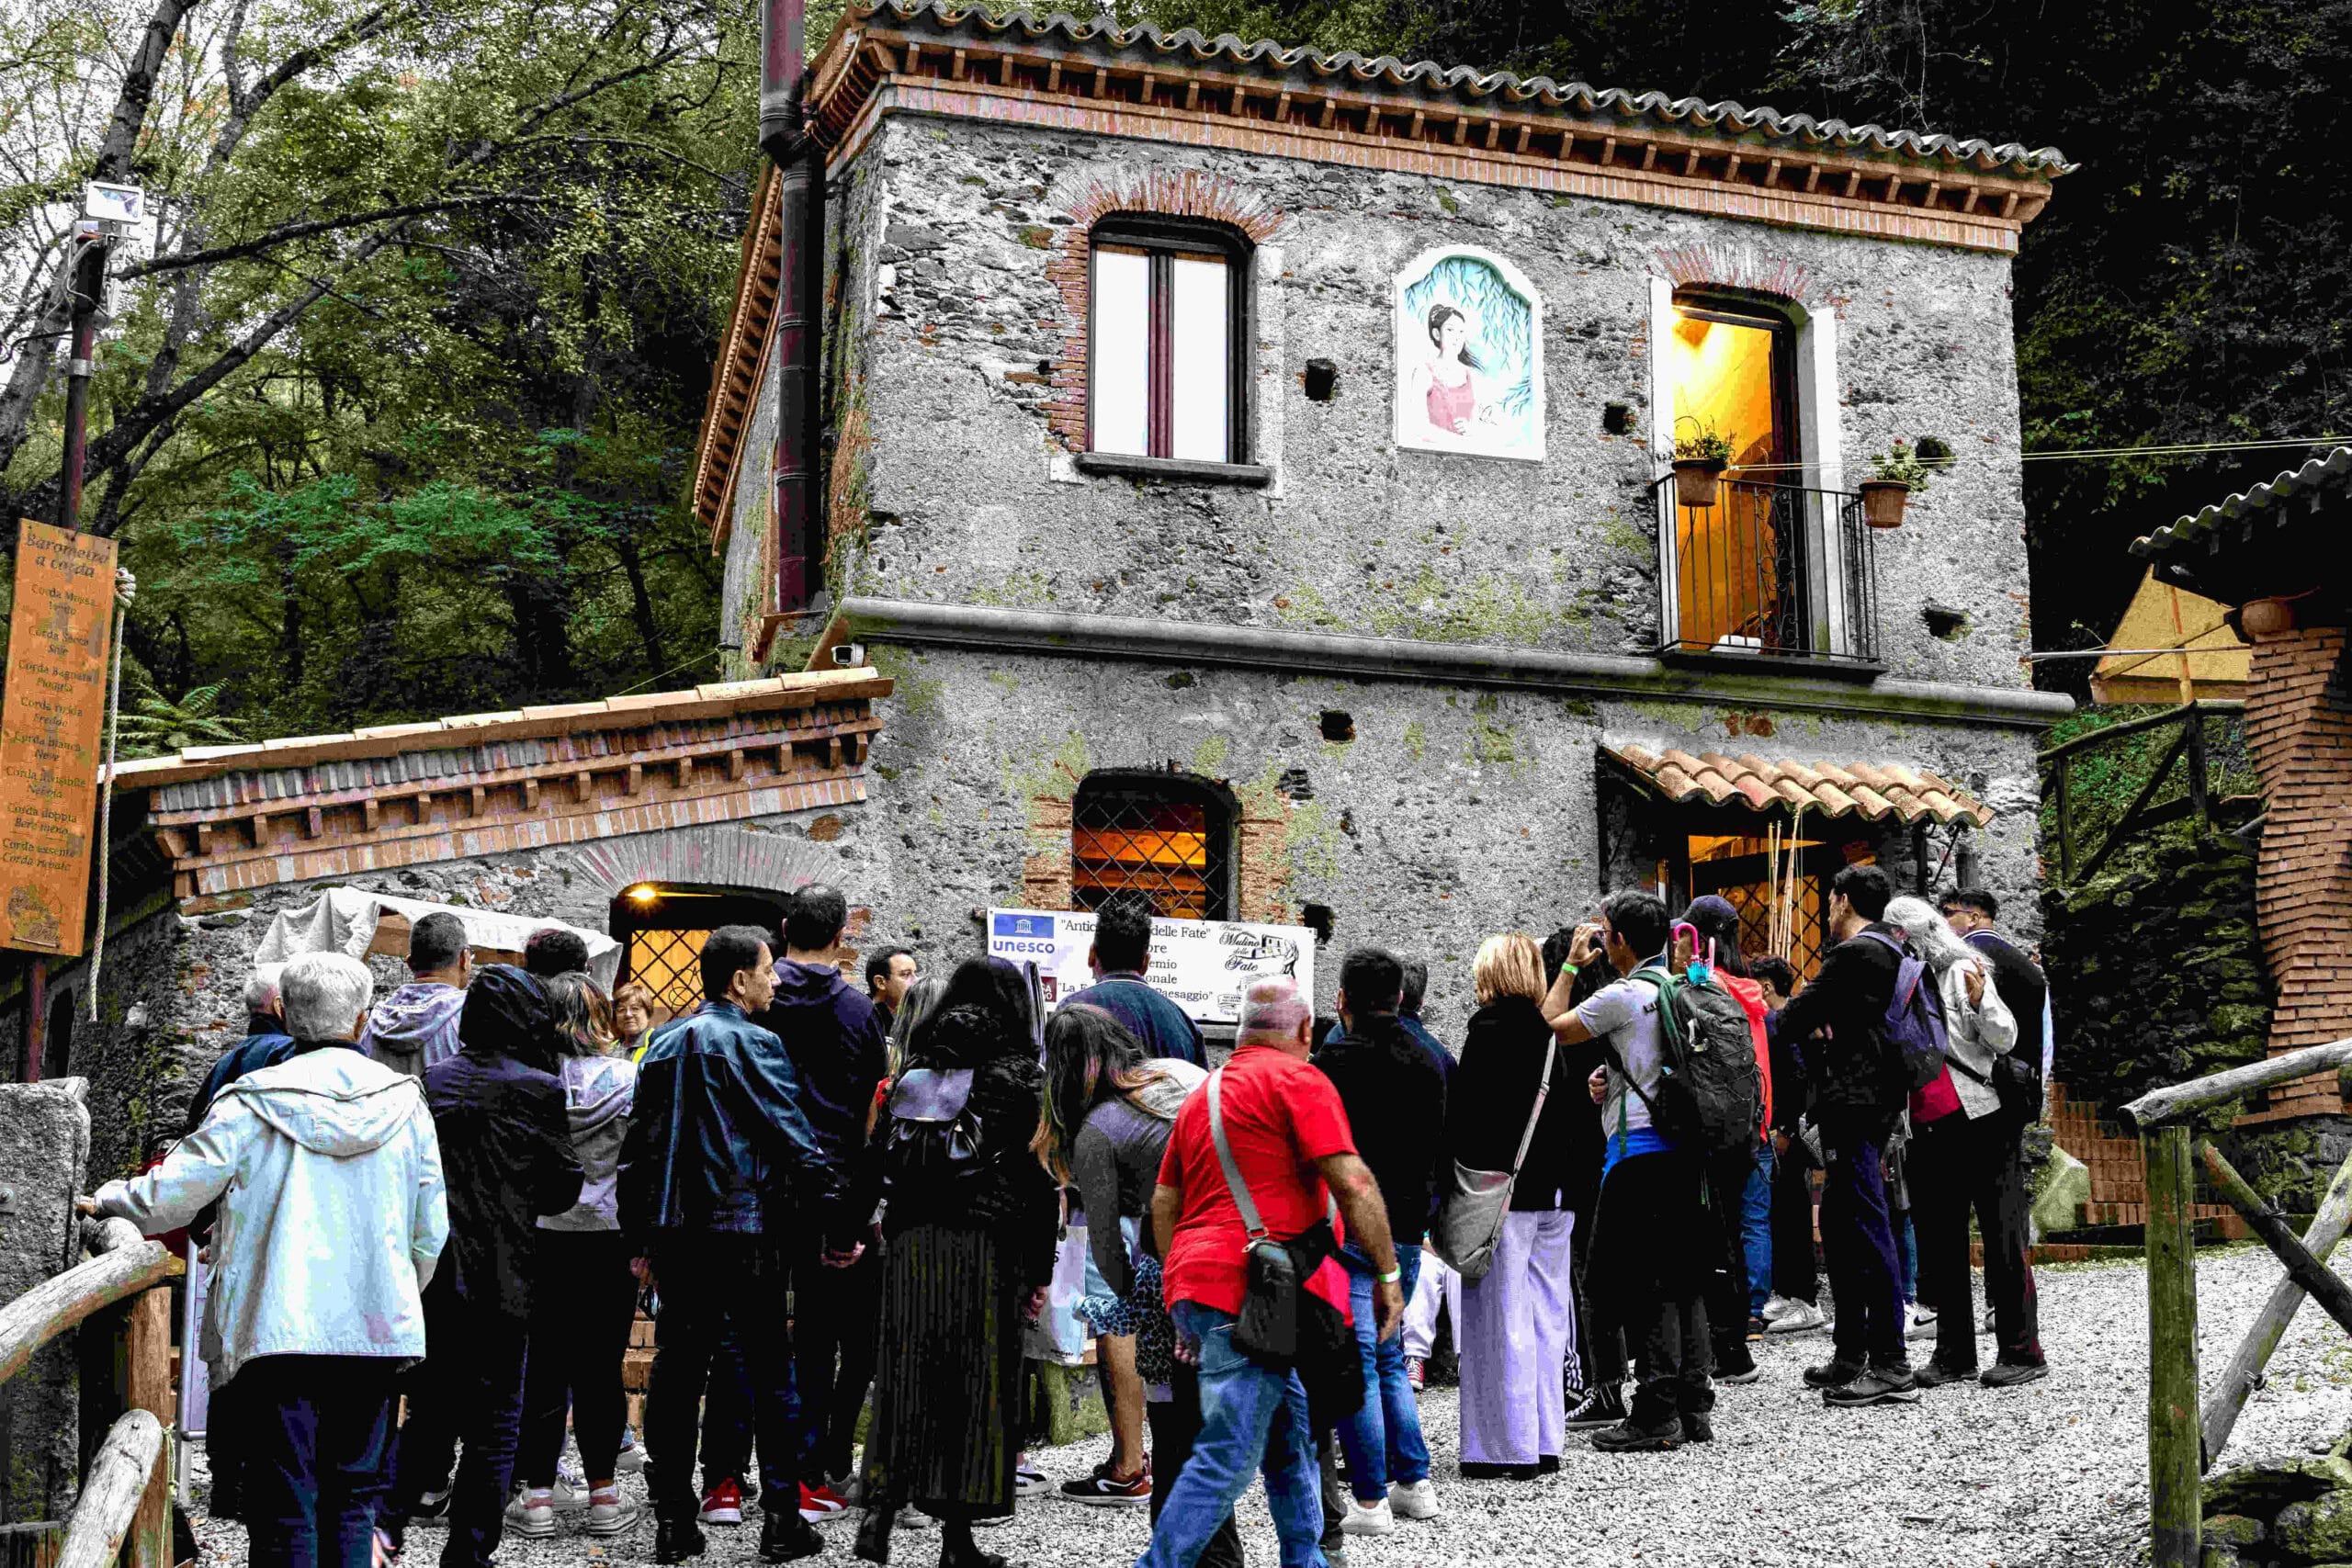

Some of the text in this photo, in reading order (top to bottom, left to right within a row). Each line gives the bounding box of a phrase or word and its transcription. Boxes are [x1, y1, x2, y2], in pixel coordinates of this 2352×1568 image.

[27, 533, 109, 564] Barometro
[37, 556, 96, 578] a corda
[31, 583, 62, 599] Corda
[28, 625, 60, 642] Corda
[18, 660, 50, 675] Corda
[20, 696, 51, 712] Corda
[15, 731, 46, 746] Corda
[35, 749, 60, 761] Neve
[6, 765, 37, 780] Corda
[7, 801, 39, 817] Corda
[3, 838, 35, 852] Corda
[3, 852, 34, 868] Corda
[1150, 924, 1178, 937] delle
[1181, 926, 1211, 939] Fate"
[1219, 931, 1261, 947] Mulino
[992, 940, 1056, 954] unesco
[1224, 953, 1259, 972] Fate
